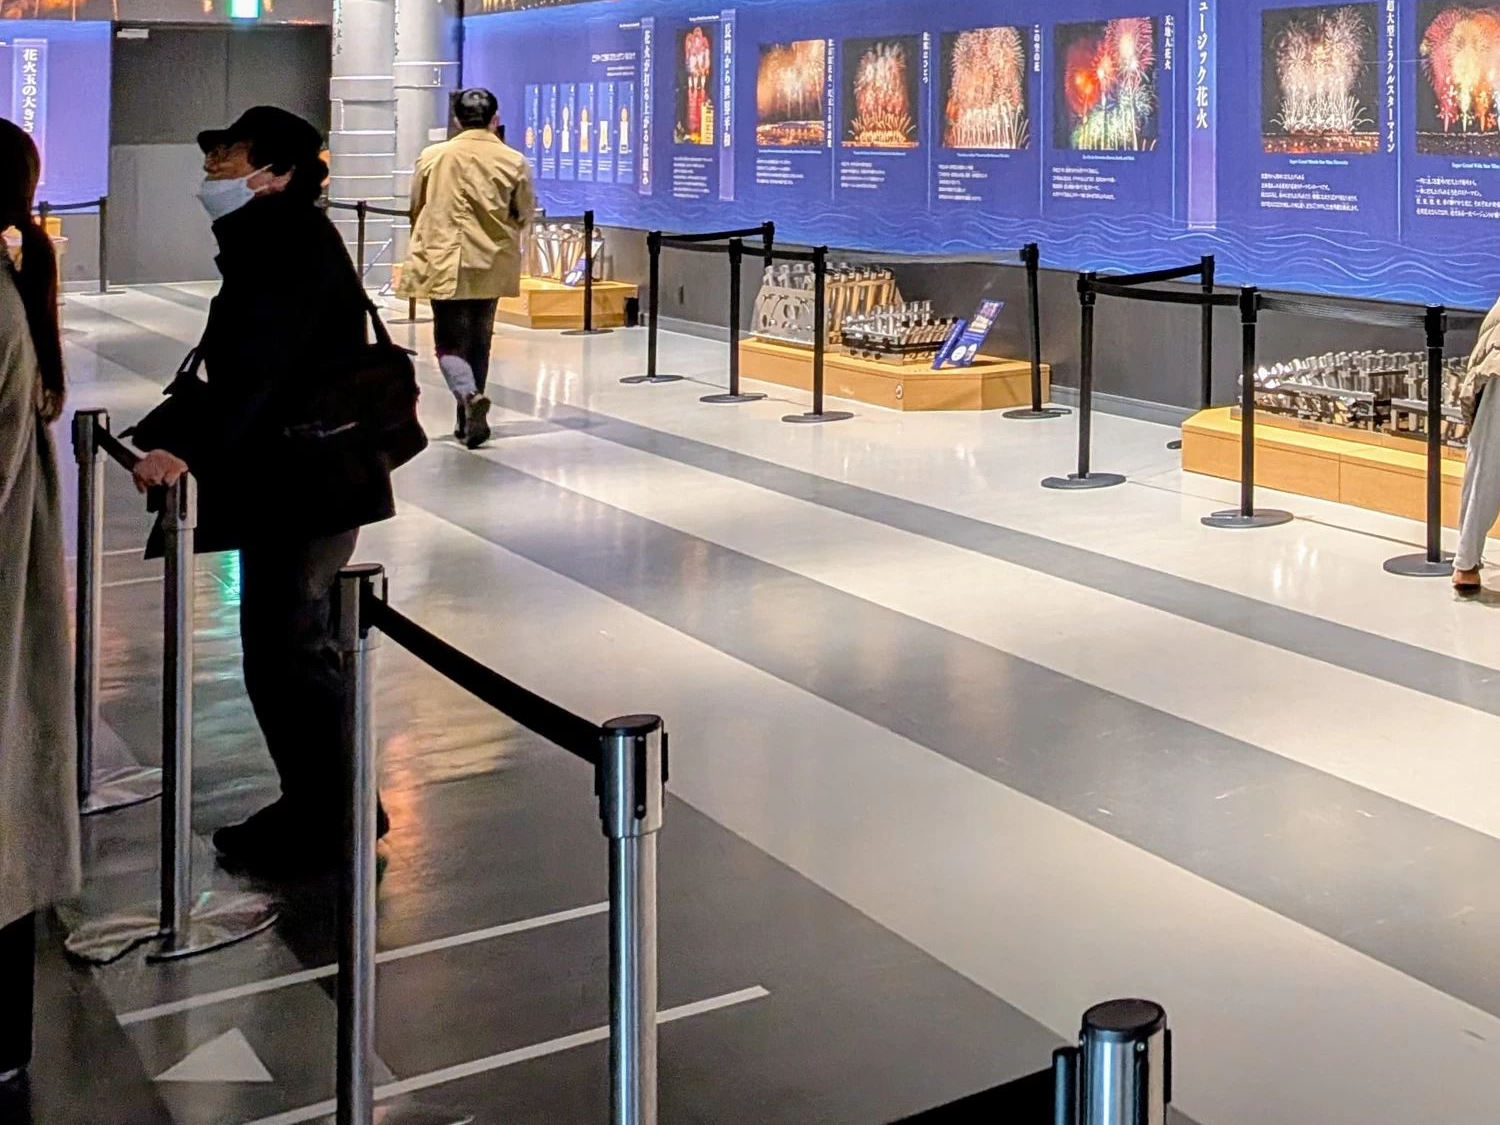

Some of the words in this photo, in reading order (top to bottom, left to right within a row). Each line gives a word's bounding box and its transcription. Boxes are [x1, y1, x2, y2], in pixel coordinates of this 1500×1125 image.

[22, 48, 38, 133] 花火玉の大きさ
